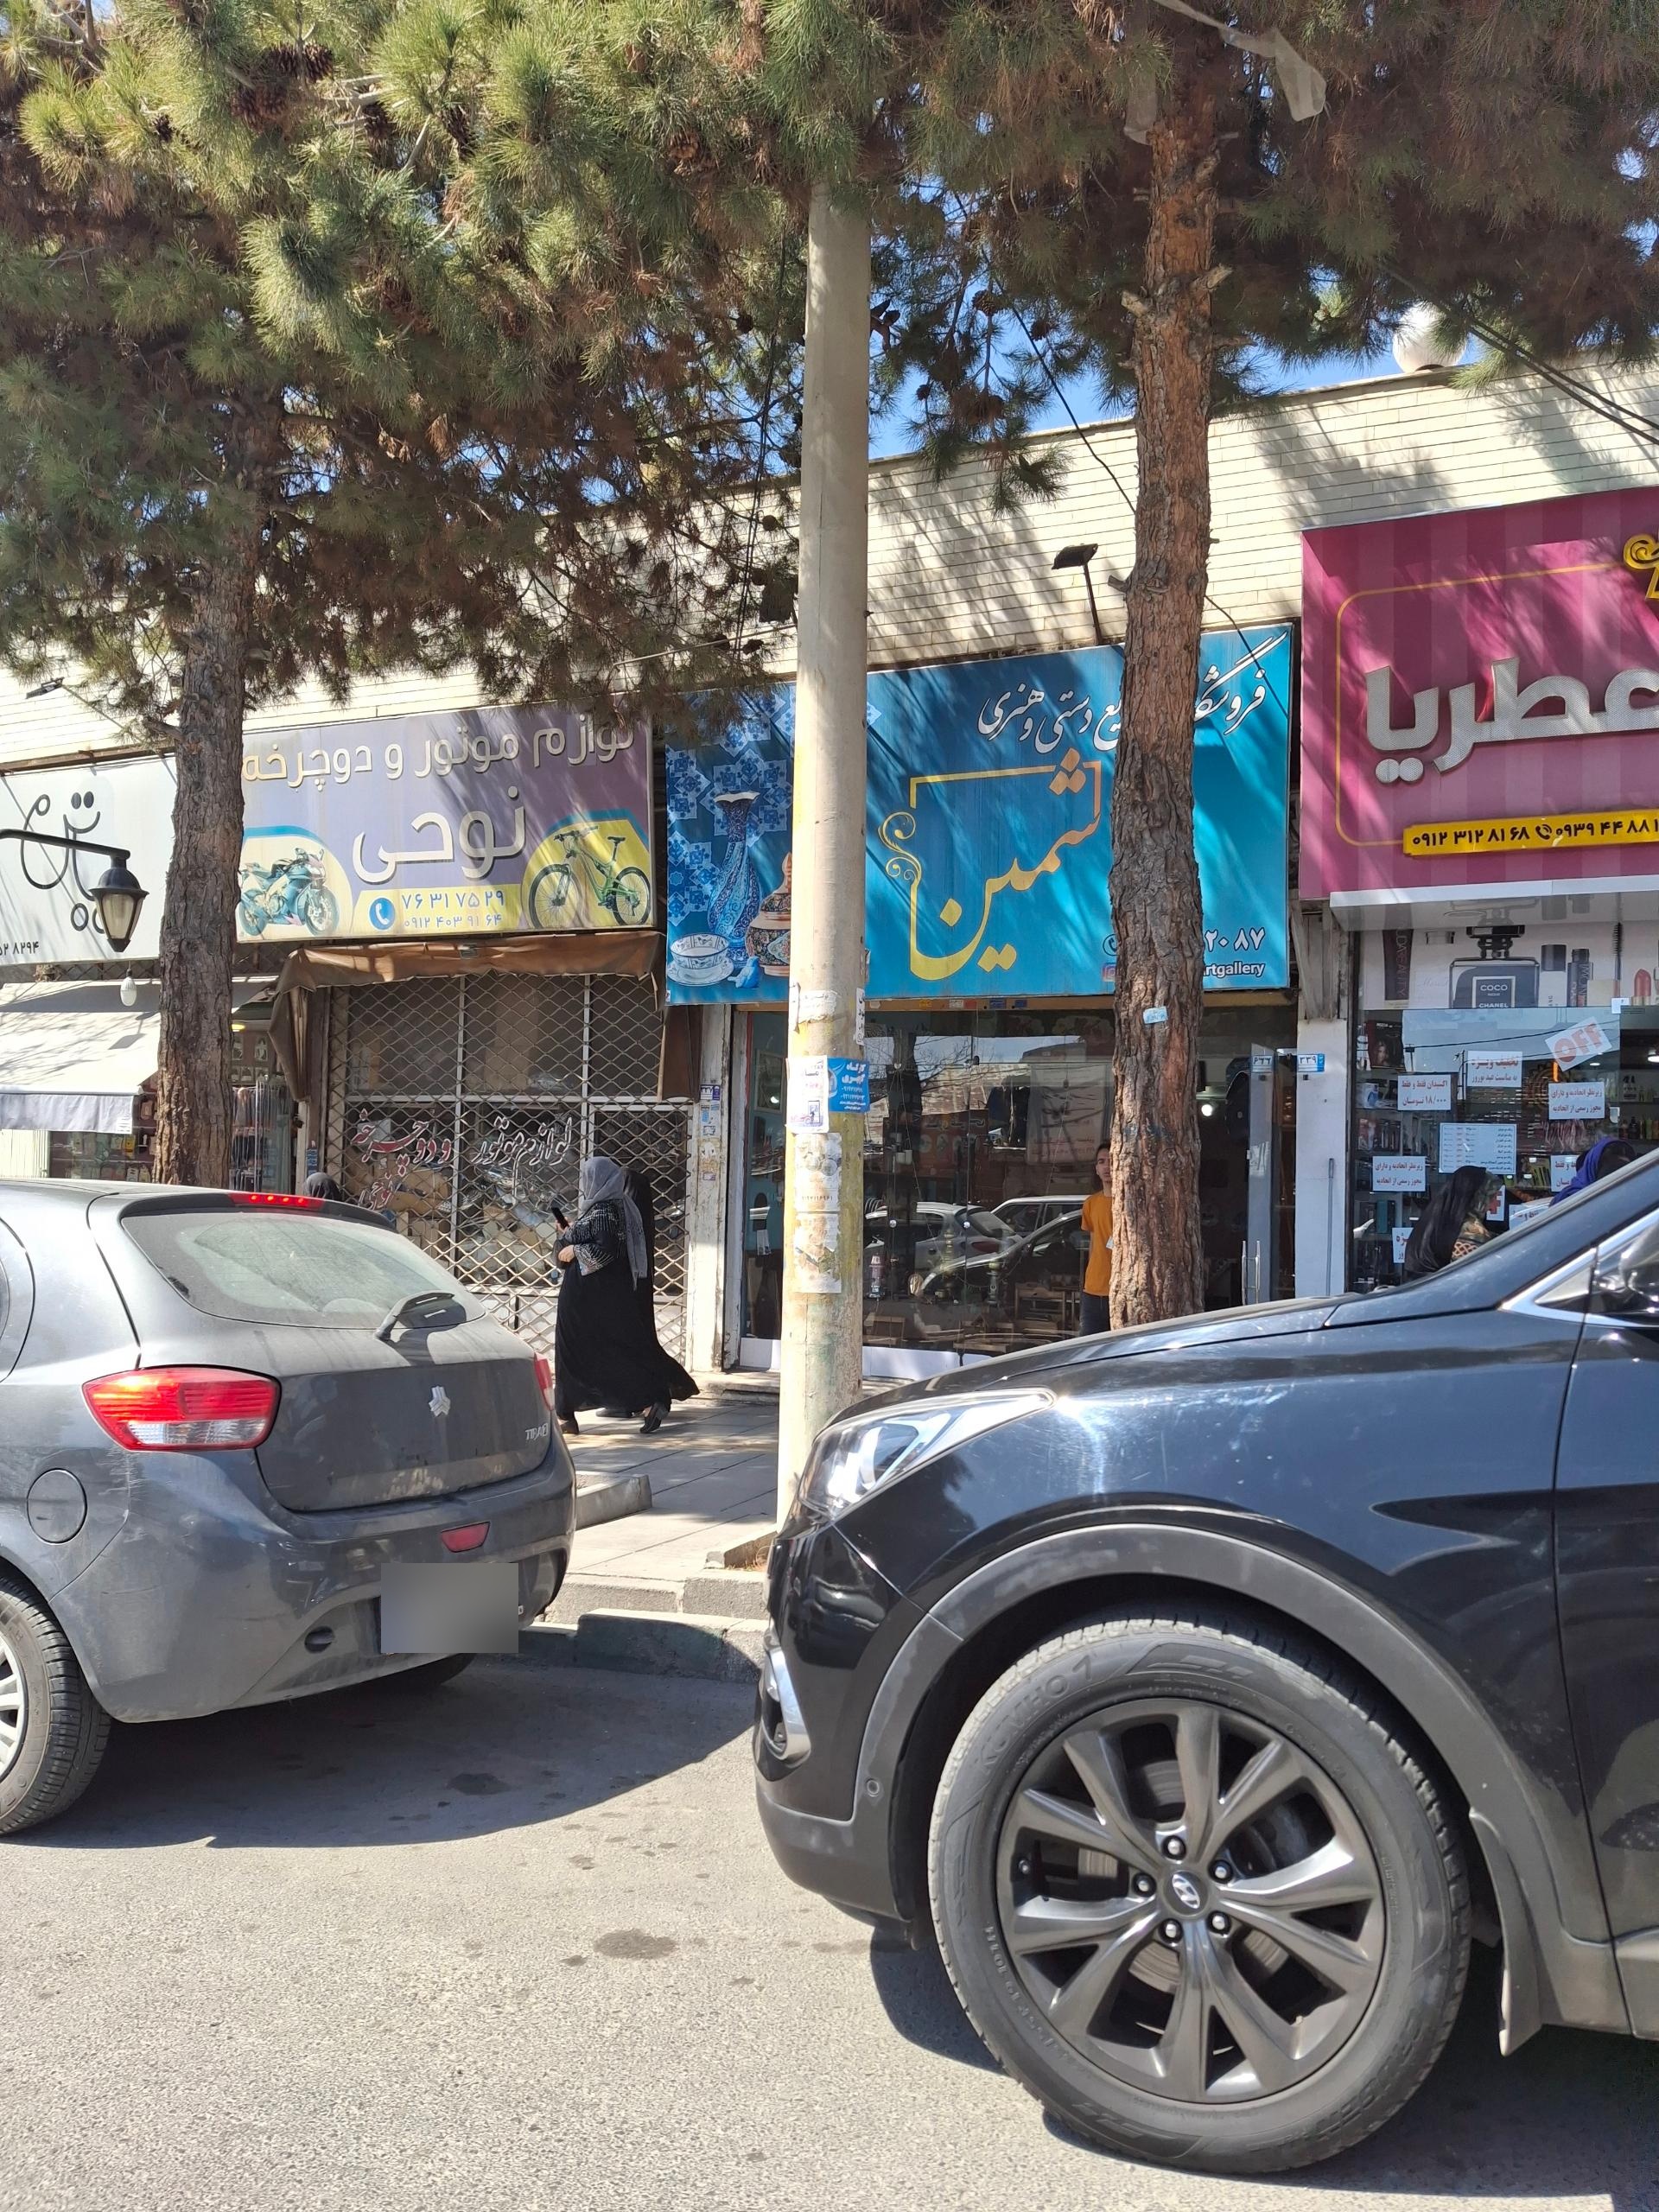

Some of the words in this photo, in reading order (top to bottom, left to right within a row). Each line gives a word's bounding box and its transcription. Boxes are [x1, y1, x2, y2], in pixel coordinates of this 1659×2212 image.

[977, 683, 1045, 741] هنری
[383, 743, 404, 779] و
[414, 726, 519, 779] موتور
[353, 785, 526, 885] نوحی
[1412, 831, 1448, 847] ۰۹۱۲
[1453, 829, 1484, 845] ۳۱۲
[1487, 827, 1506, 842] ۸۱
[1510, 826, 1530, 841] ۶۸
[1626, 819, 1647, 834] ۸۸
[402, 893, 423, 909] ۷۶
[429, 892, 449, 908] ۳۱
[455, 892, 480, 908] ۷۵
[485, 890, 505, 906] ۲۹
[404, 918, 431, 928] ۰۹۱۲
[467, 916, 480, 927] ۹۱
[12, 941, 40, 955] ۸۲۹۴
[1233, 927, 1266, 951] ۸۷
[1554, 1022, 1603, 1064] OFF
